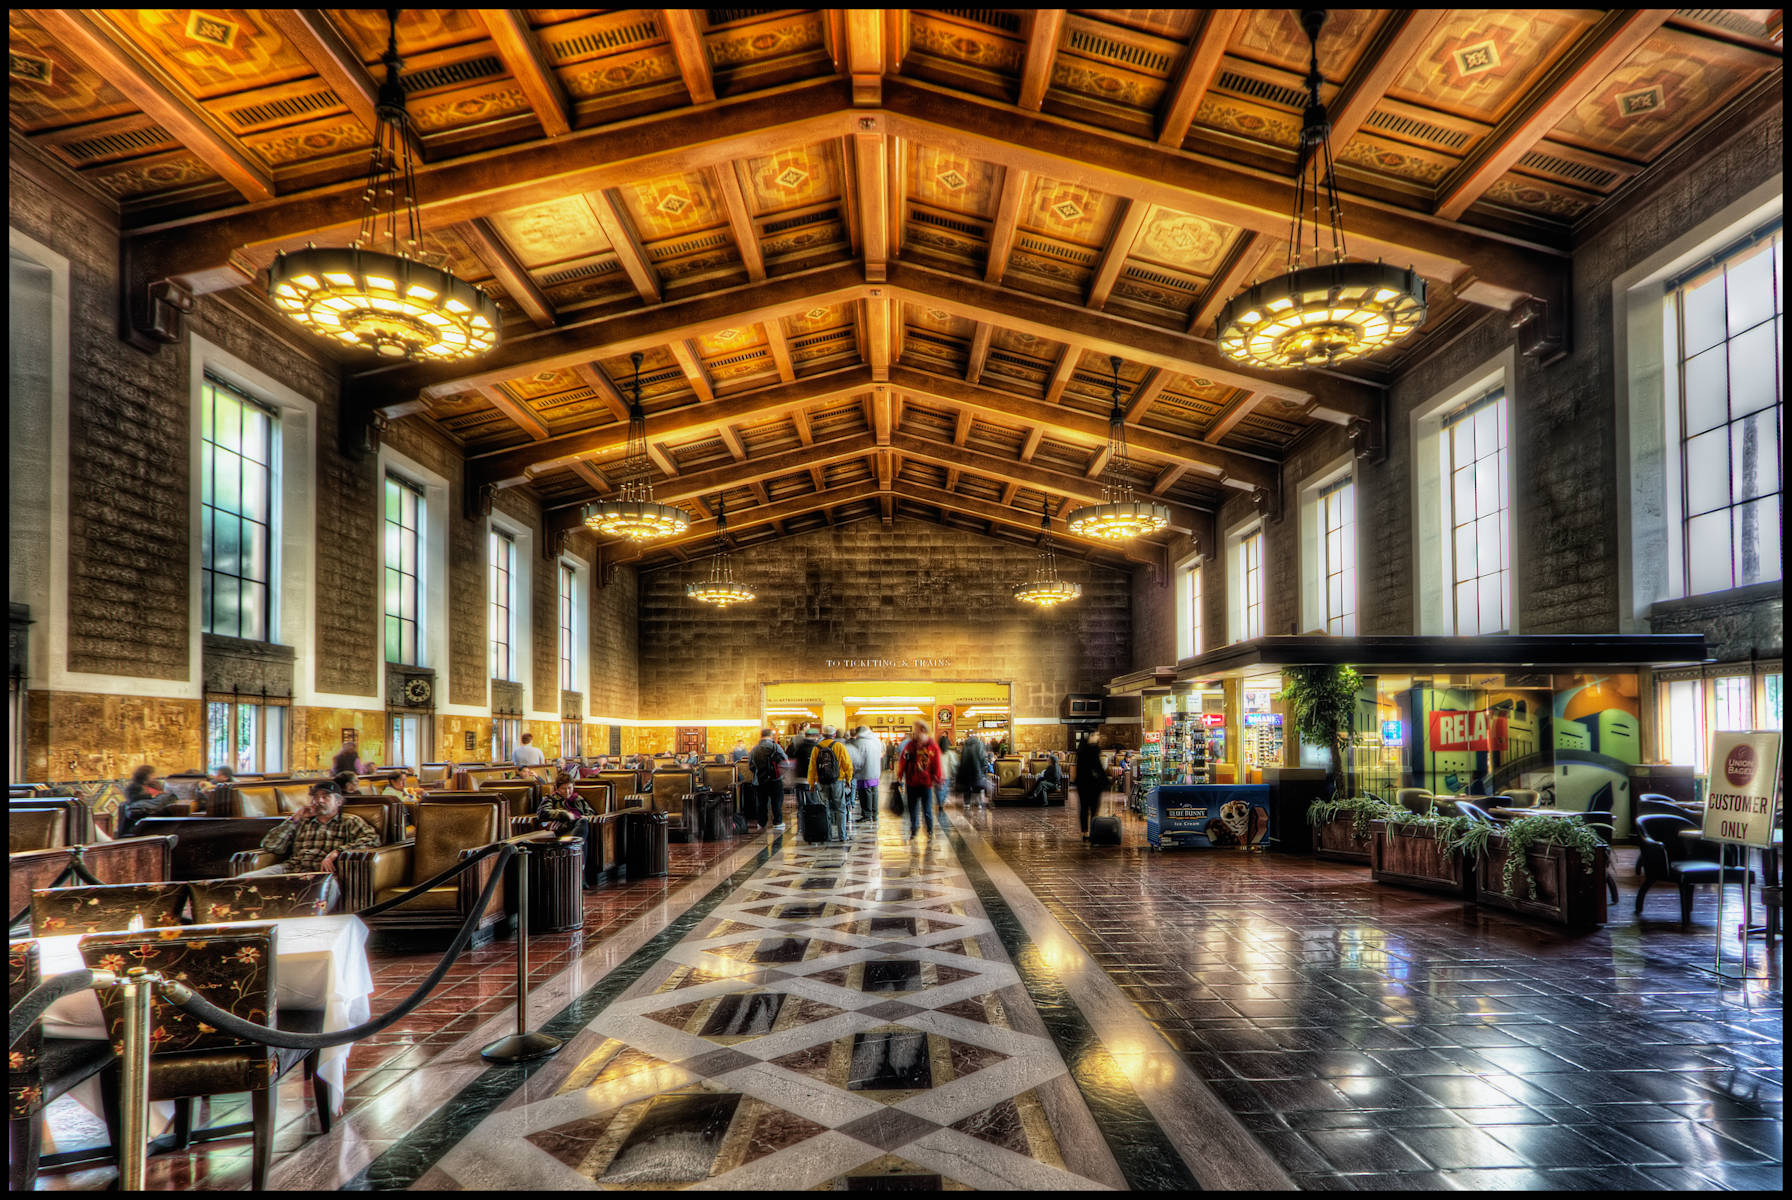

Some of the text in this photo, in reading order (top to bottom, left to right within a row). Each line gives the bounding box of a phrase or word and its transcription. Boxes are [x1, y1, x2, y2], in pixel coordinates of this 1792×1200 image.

[826, 659, 951, 668] TO TICKETING & TRAINS
[1728, 759, 1753, 767] UNION
[1709, 793, 1768, 814] CUSTOMER
[1721, 820, 1748, 839] ONLY
